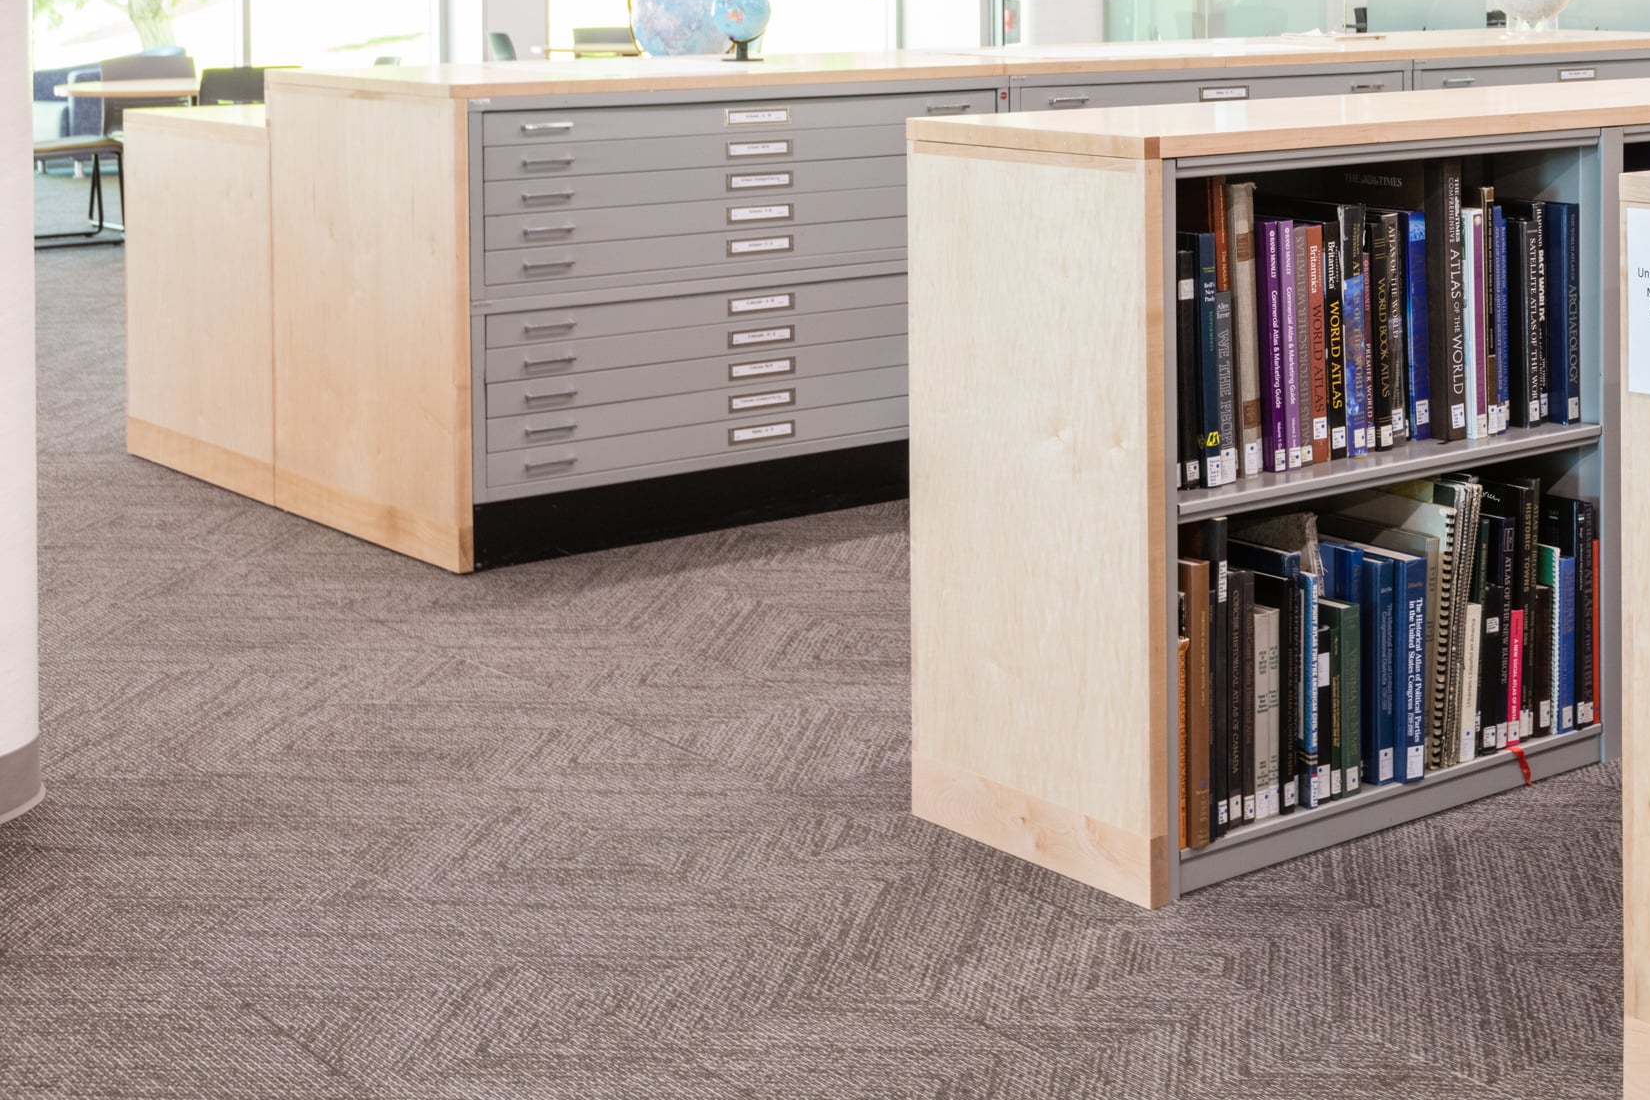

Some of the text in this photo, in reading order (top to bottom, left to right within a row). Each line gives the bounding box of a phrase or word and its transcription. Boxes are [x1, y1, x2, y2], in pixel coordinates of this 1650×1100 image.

[1310, 245, 1320, 293] Britannica
[1328, 241, 1337, 288] Britannica
[1388, 226, 1400, 339] ATLAS OF THE WORLD
[1450, 249, 1461, 299] ATLAS
[1271, 290, 1279, 326] Commercial
[1454, 302, 1460, 314] OF
[1530, 238, 1539, 373] SATELLITE ATLAS OF THE
[1352, 260, 1363, 401] ATLAS OF THE WORLD
[1378, 277, 1390, 398] WORLD BOOK ATLAS
[1568, 285, 1579, 384] ARCHAEOLOGY
[1273, 353, 1281, 386] Marketing
[1287, 350, 1295, 383] Marketing
[1312, 304, 1325, 412] WORLD ATLAS
[1330, 301, 1342, 409] WORLD ATLAS
[1452, 334, 1463, 394] WORLD
[1523, 503, 1532, 592] HISTORIC TOWNS
[1504, 556, 1512, 584] ATLAS
[1409, 600, 1416, 608] in
[1415, 598, 1423, 612] The
[1504, 586, 1511, 600] OF
[1415, 614, 1423, 652] Historical
[1415, 653, 1423, 669] Atlas
[1415, 671, 1423, 680] of
[1501, 647, 1509, 684] EUROPE
[1231, 590, 1240, 774] CONCISE HISTORICAL ATLAS OF CANADA
[1407, 673, 1415, 710] Congress
[1414, 683, 1422, 714] Political
[1414, 716, 1422, 742] Parties
